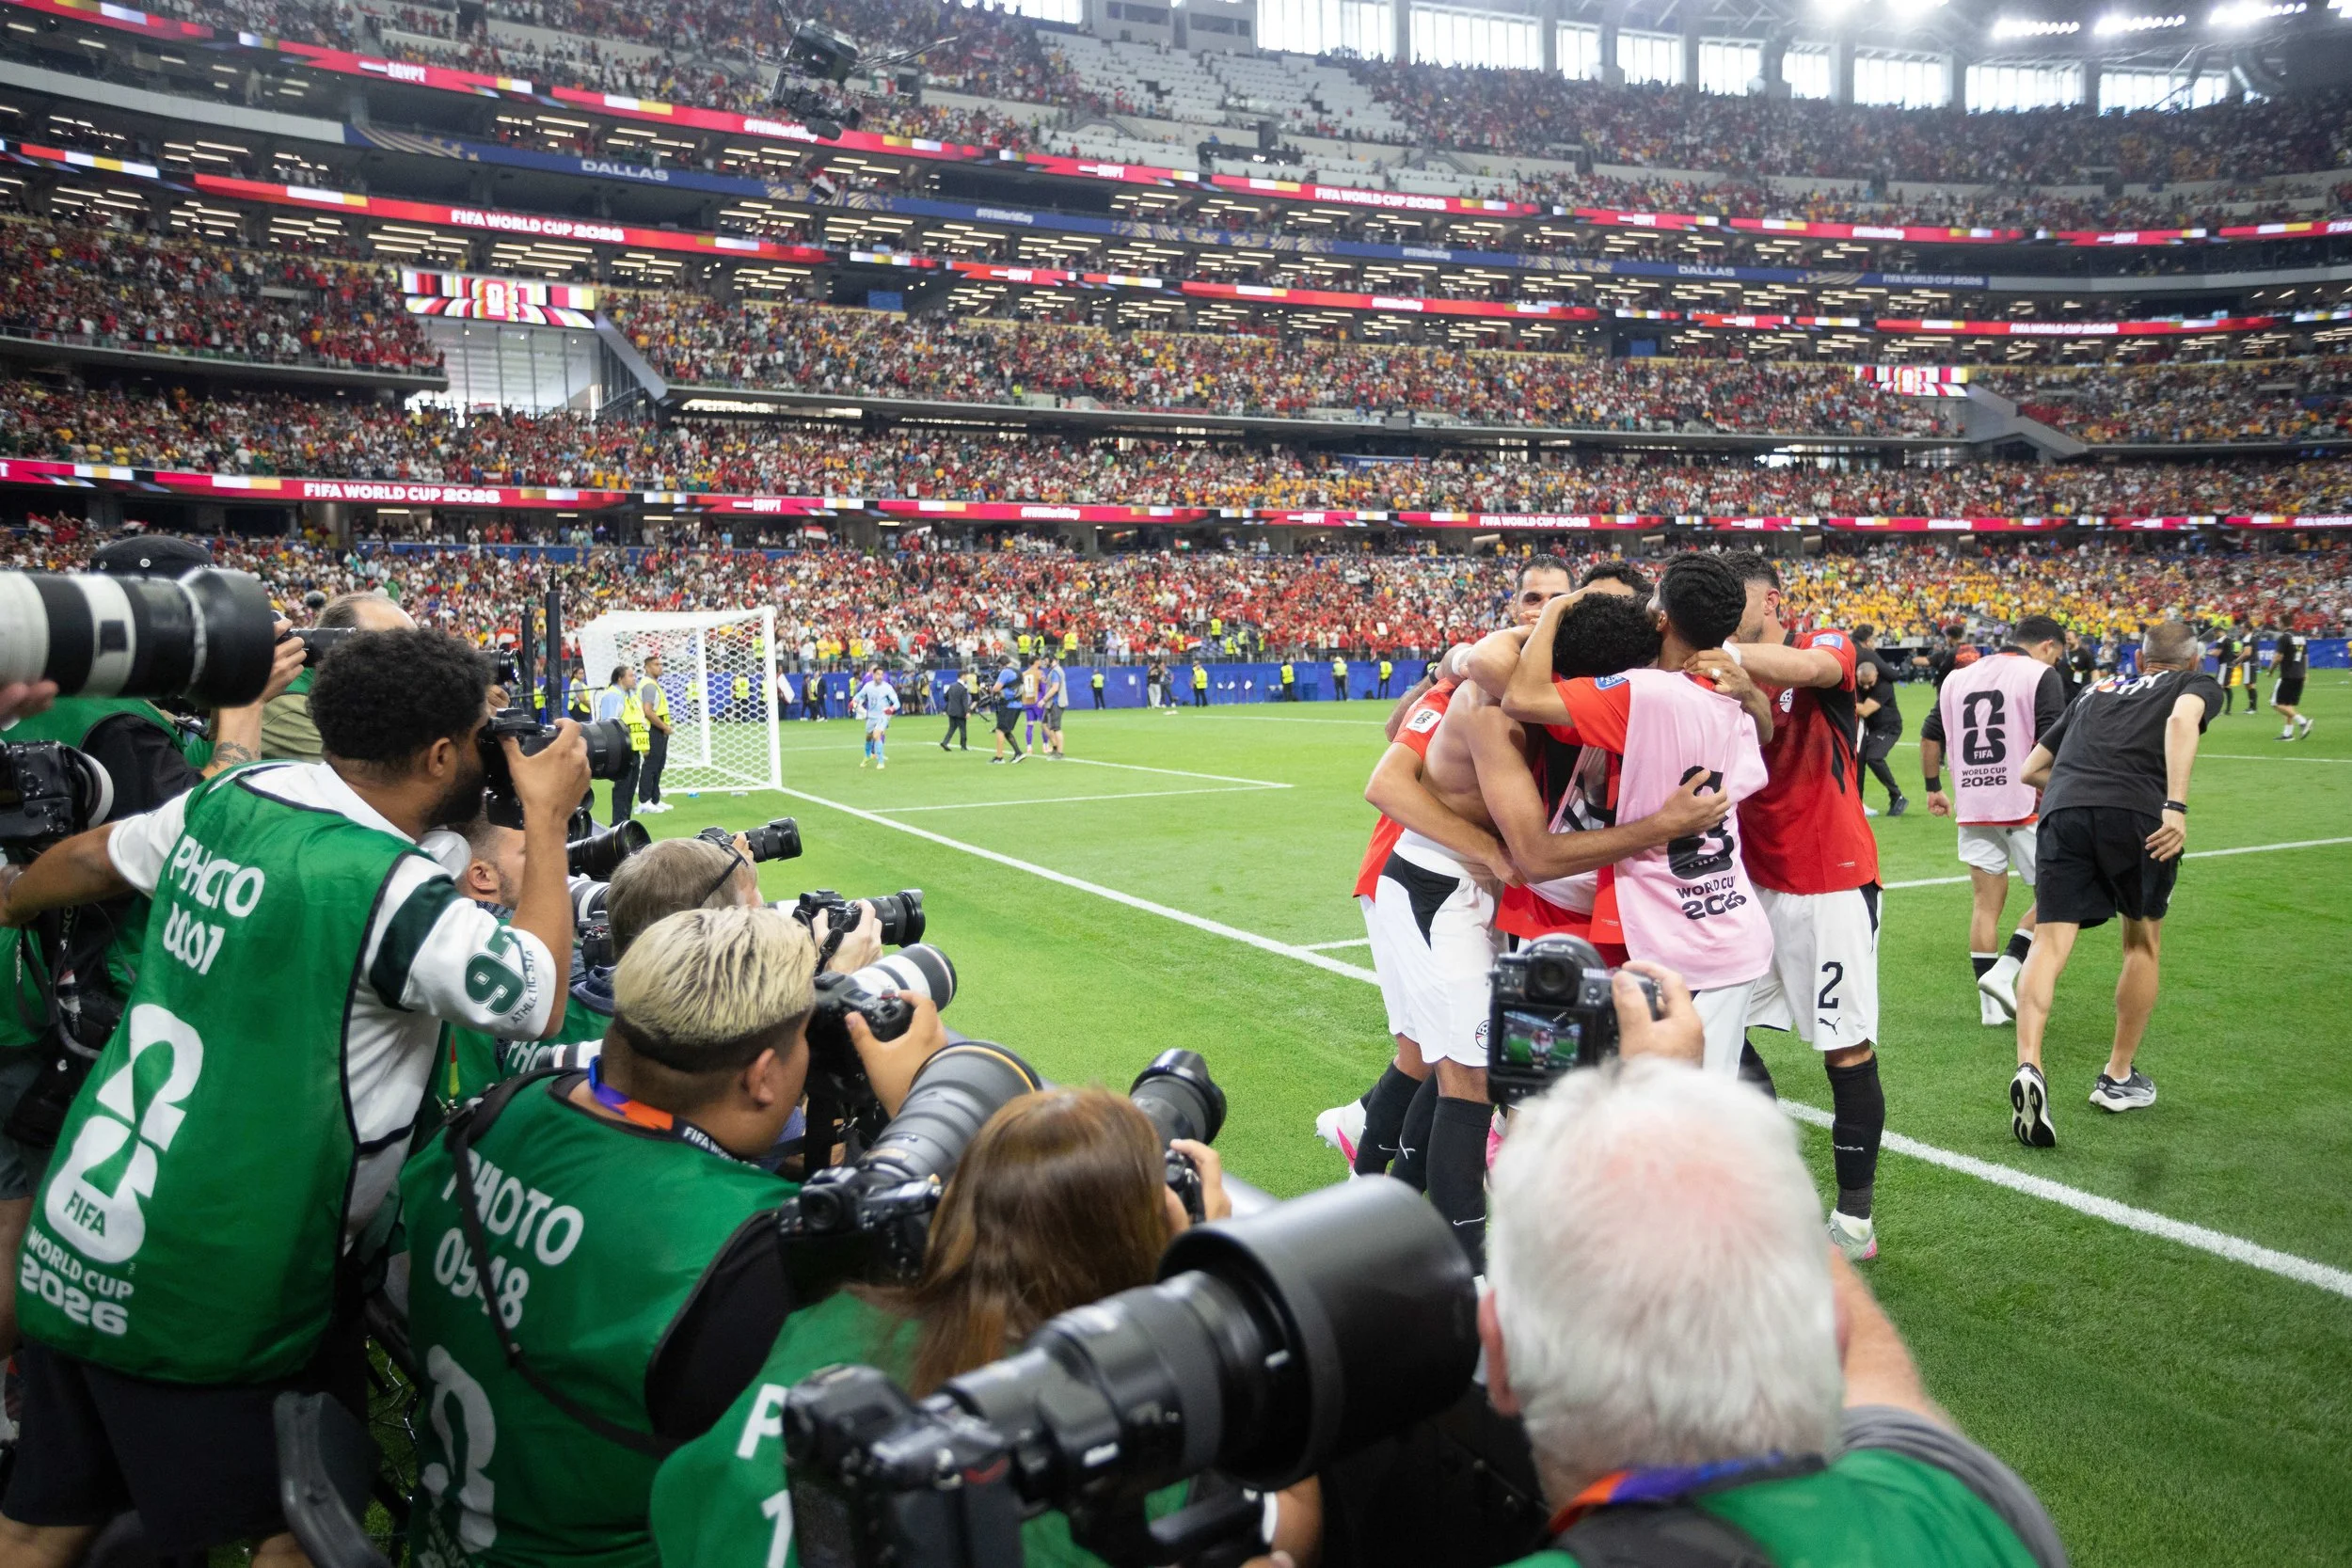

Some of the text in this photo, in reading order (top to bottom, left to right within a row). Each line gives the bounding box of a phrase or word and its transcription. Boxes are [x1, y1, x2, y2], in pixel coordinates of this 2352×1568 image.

[581, 160, 669, 182] DALLAS
[1315, 187, 1341, 200] FIFA
[1341, 189, 1382, 205] WORLD
[1382, 194, 1406, 207] CUP
[451, 209, 625, 242] FIFA WORLD CUP 2026
[1677, 264, 1736, 277] DALLAS
[1883, 274, 1902, 284] FIFA
[1902, 275, 1933, 285] WORLD
[1934, 276, 1952, 285] CUP
[303, 482, 501, 504] FIFA WORLD CUP 2026
[1480, 515, 1501, 527] FIFA
[1501, 515, 1536, 527] WORLD
[1536, 516, 1556, 527] CUP
[1974, 749, 1994, 760] FIFA
[1962, 768, 1989, 777] WORLD
[1962, 775, 2007, 788] 2026
[1721, 875, 1736, 889] CU
[1817, 960, 1844, 1009] 2
[683, 1126, 709, 1149] FIFA
[63, 1189, 106, 1238] FIFA
[441, 1148, 584, 1266] PHOTO
[26, 1225, 135, 1300] WORLD CUP
[20, 1254, 130, 1337] 2026
